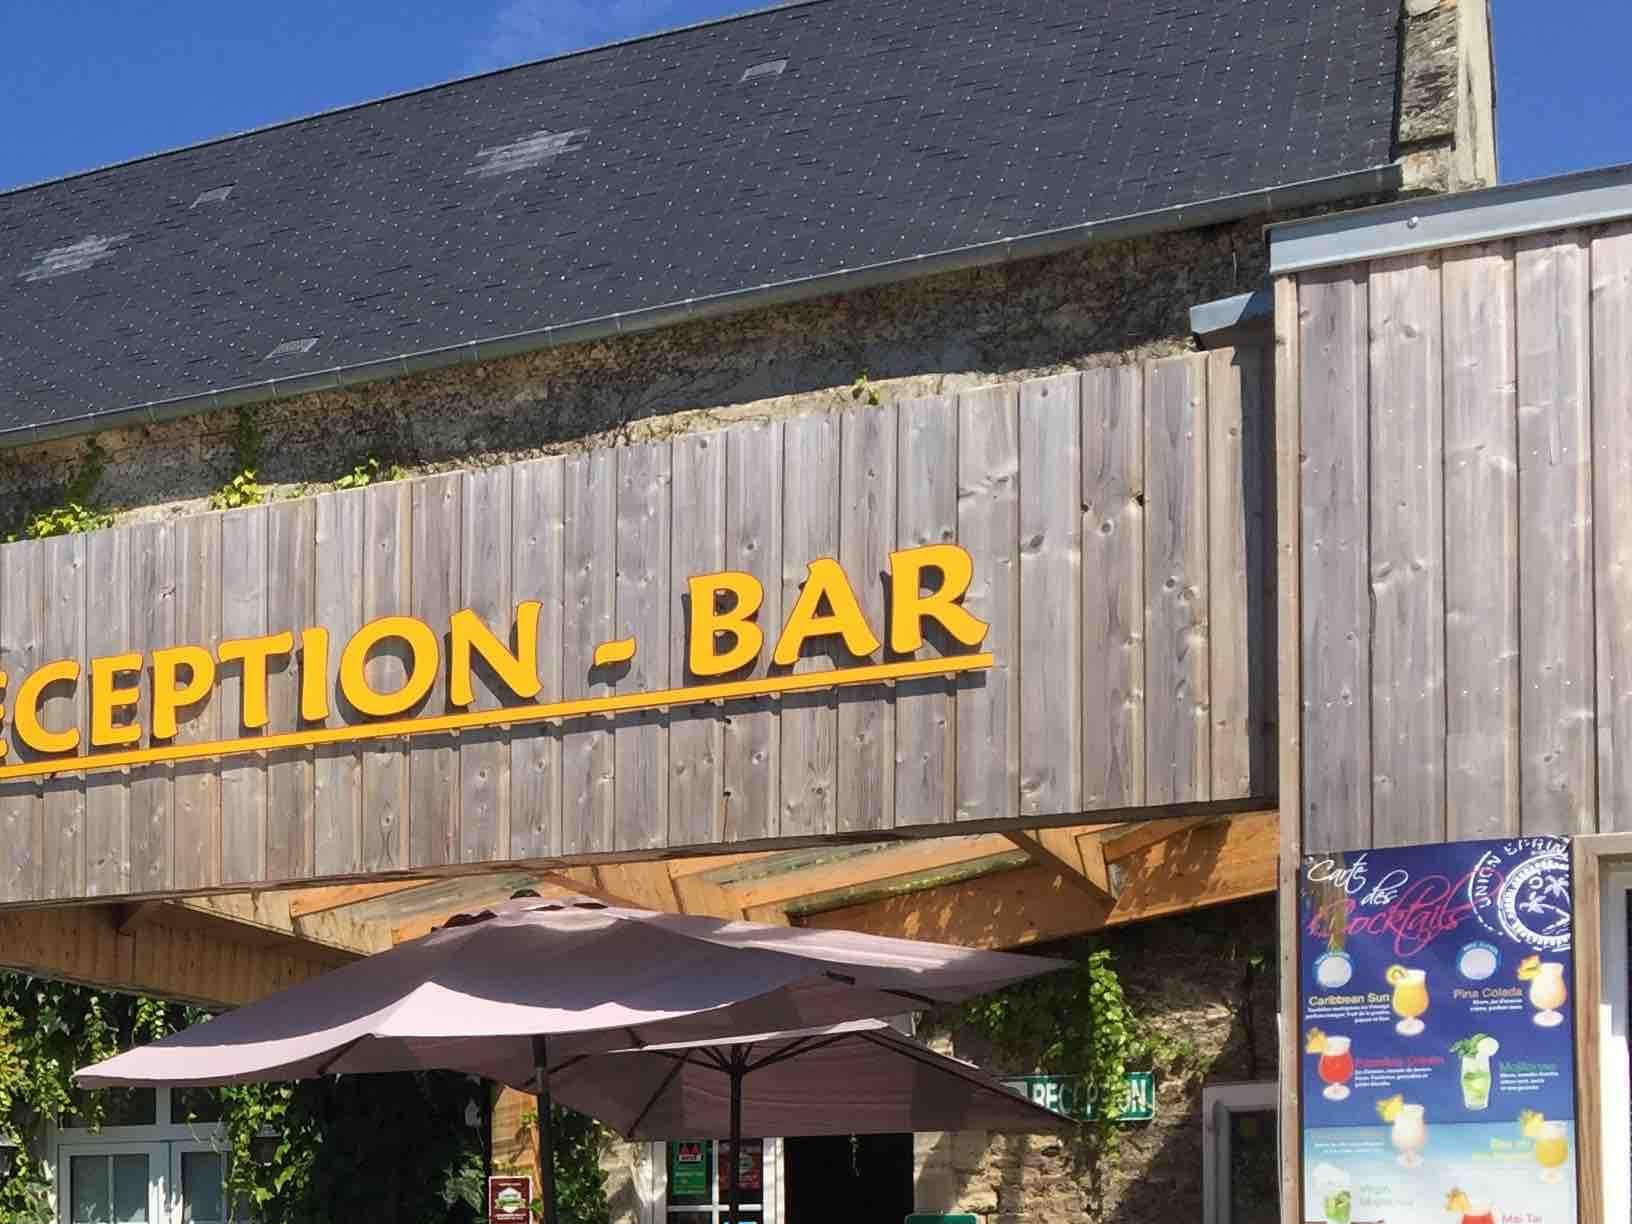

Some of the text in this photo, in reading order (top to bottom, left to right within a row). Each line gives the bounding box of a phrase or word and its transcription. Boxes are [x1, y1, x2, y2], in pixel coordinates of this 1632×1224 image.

[688, 543, 989, 676] BAR
[1307, 853, 1368, 894] Carte
[1361, 869, 1409, 906] des
[1308, 873, 1486, 957] Cocktails
[1368, 992, 1390, 1003] Sun
